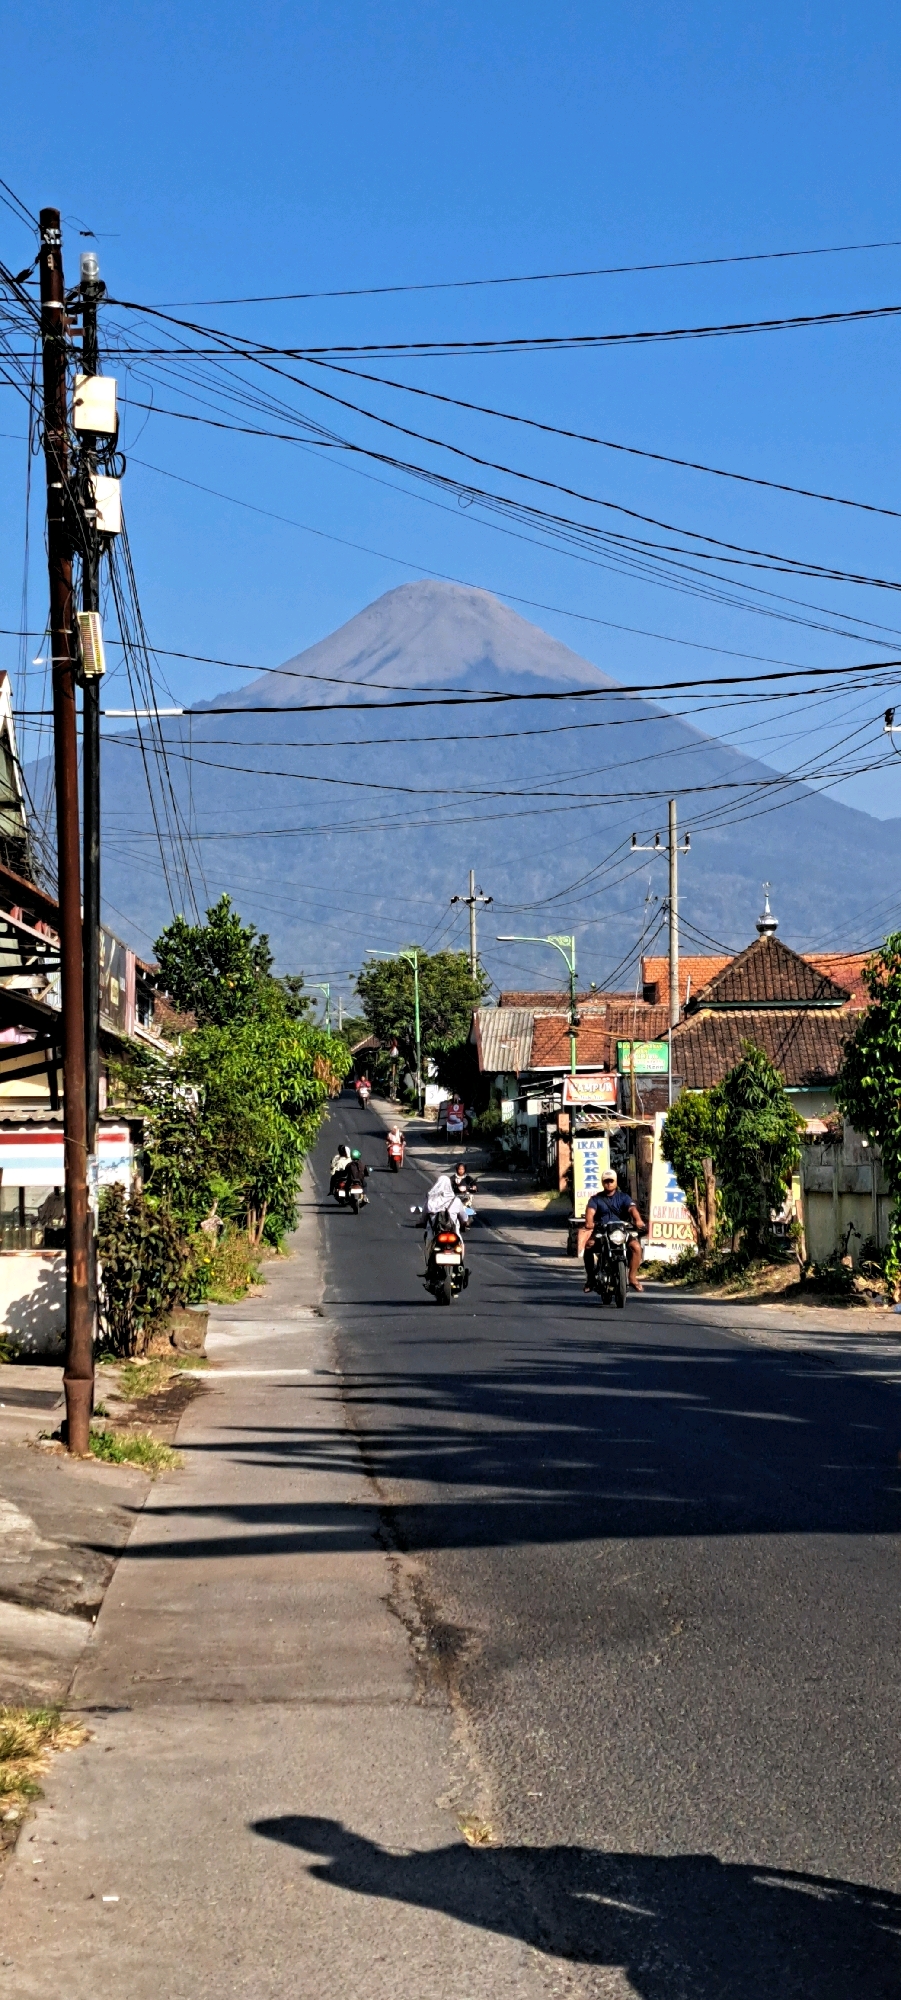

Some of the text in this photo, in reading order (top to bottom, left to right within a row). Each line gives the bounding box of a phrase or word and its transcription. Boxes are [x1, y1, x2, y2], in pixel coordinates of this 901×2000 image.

[577, 1141, 604, 1150] IKAN
[583, 1152, 600, 1190] BAKAR
[652, 1222, 694, 1241] BUKA
